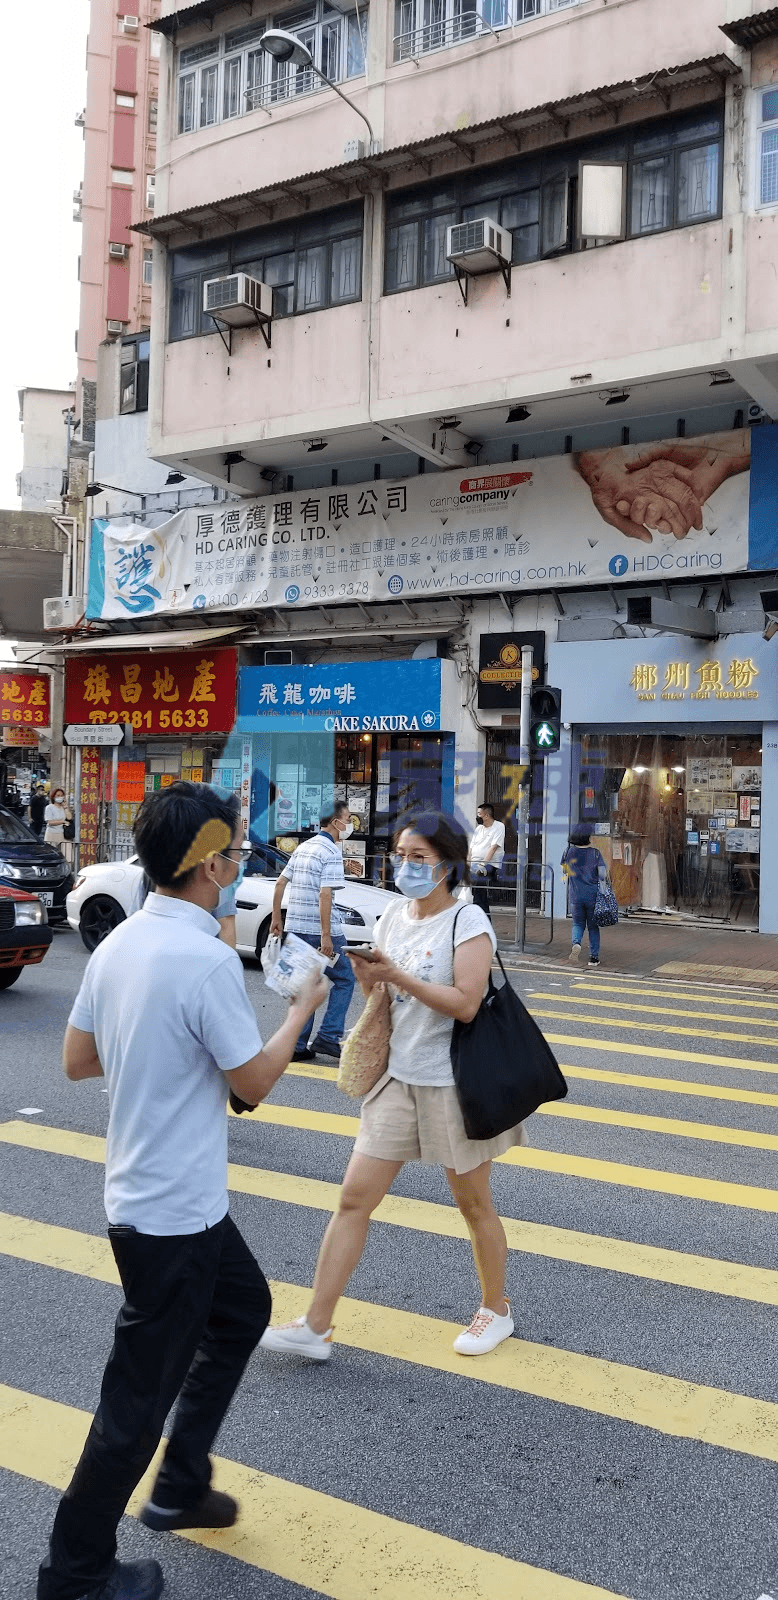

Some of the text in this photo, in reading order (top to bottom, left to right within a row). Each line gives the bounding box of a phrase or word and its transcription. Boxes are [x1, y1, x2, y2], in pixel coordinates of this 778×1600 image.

[195, 486, 407, 538] 厚德護理有限公司
[195, 526, 330, 555] HD CARING CO. LTD.
[195, 526, 509, 572] 基本起居照顧 藥物注射傷口 造口護理 24小時病房照顧
[268, 563, 313, 579] 兒童託管
[325, 552, 421, 574] 註冊社工跟進個案
[436, 545, 488, 563] 術後護理
[503, 540, 531, 558] 陪診
[633, 551, 722, 572] HDCaring
[406, 560, 587, 590] www.hd-caring.com.hk
[208, 592, 239, 608] 8100
[304, 580, 369, 599] 9333 3378
[83, 659, 216, 705] 旗昌地產
[629, 658, 759, 692] 郴州魚粉
[1, 679, 48, 706] 地產
[258, 682, 357, 705] 飛龍咖啡
[716, 690, 759, 699] NOODLES
[1, 708, 44, 723] 5633
[108, 708, 209, 729] 2381 5633
[324, 715, 420, 731] CAKE SAKURA
[74, 726, 97, 734] Boundary
